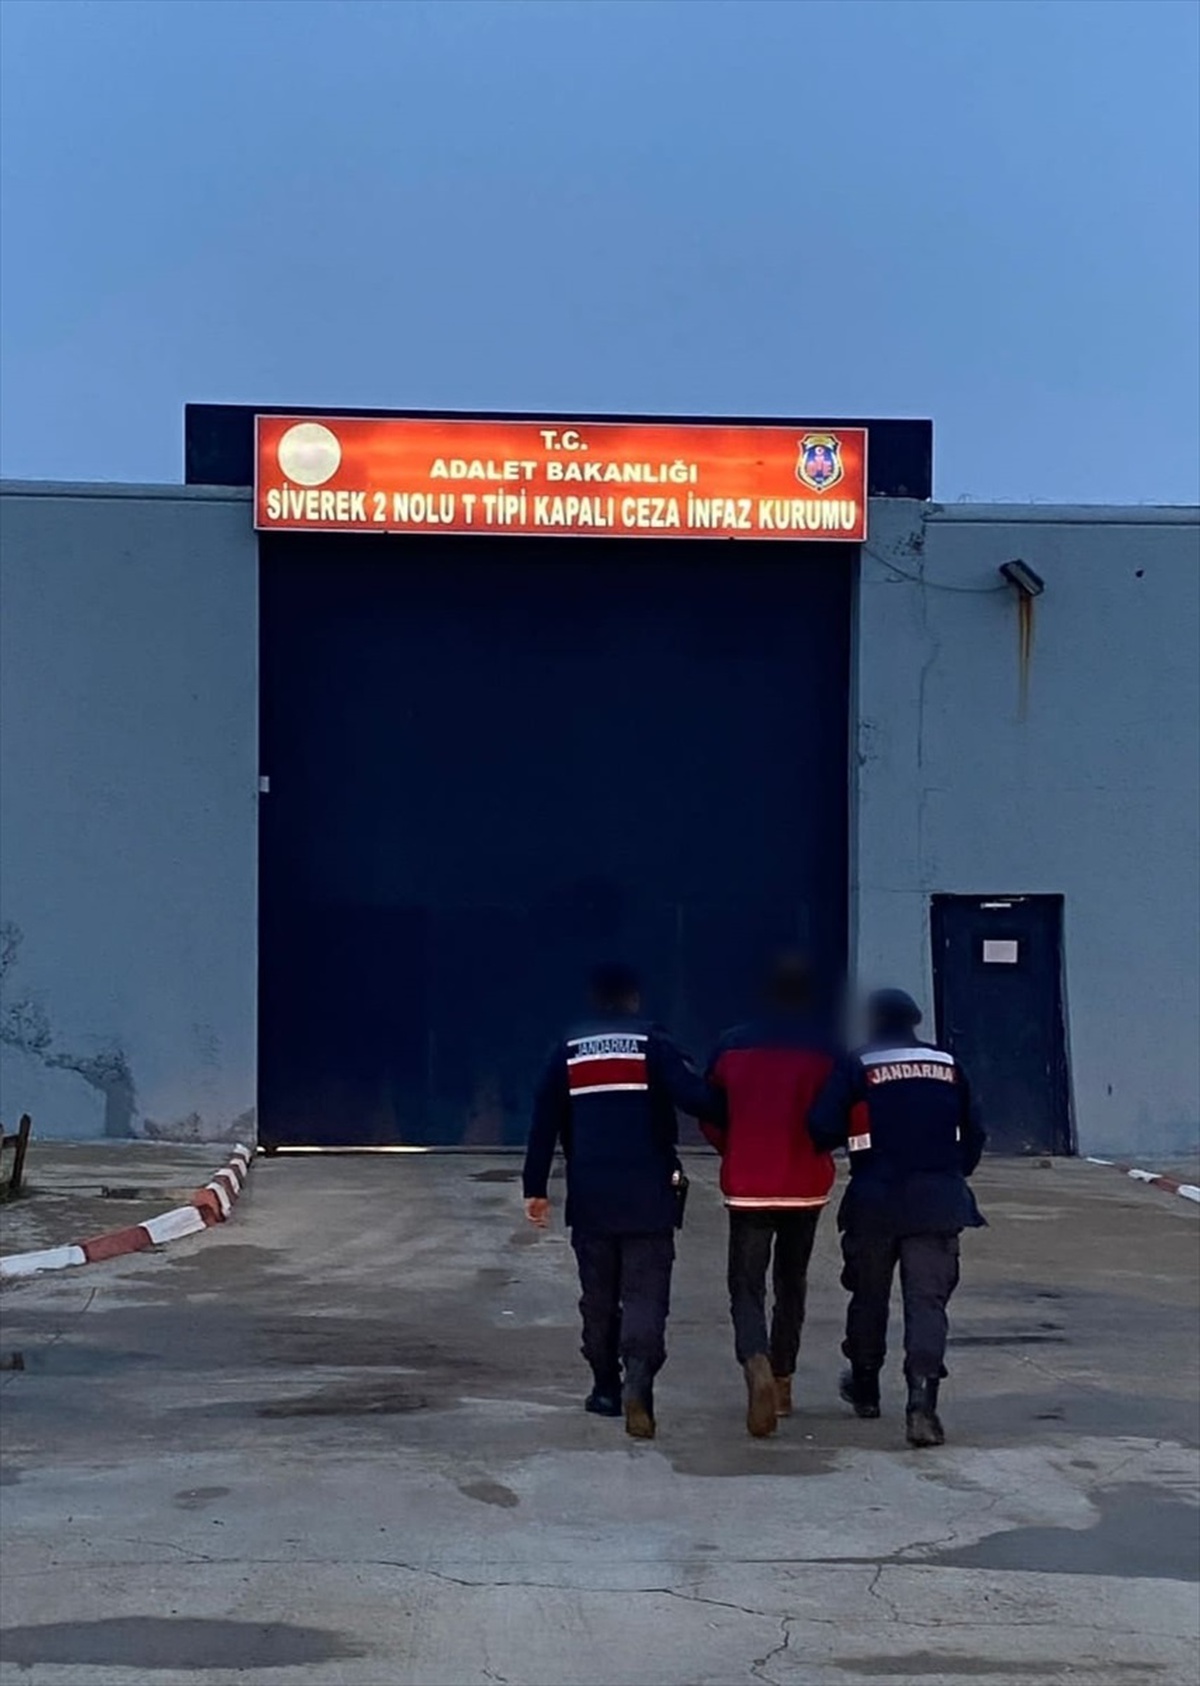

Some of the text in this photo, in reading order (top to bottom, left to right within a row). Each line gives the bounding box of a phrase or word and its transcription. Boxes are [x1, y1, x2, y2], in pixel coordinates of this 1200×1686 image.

[540, 430, 588, 450] T.C.
[430, 459, 698, 483] ADALET BAKANLIĞI
[266, 482, 856, 530] SİVEREK 2 NOLU T TİPİ KAPALI CEZA İNFAZ KURUMU
[575, 1039, 639, 1059] JANDARMA
[871, 1063, 954, 1084] JANDARMA
